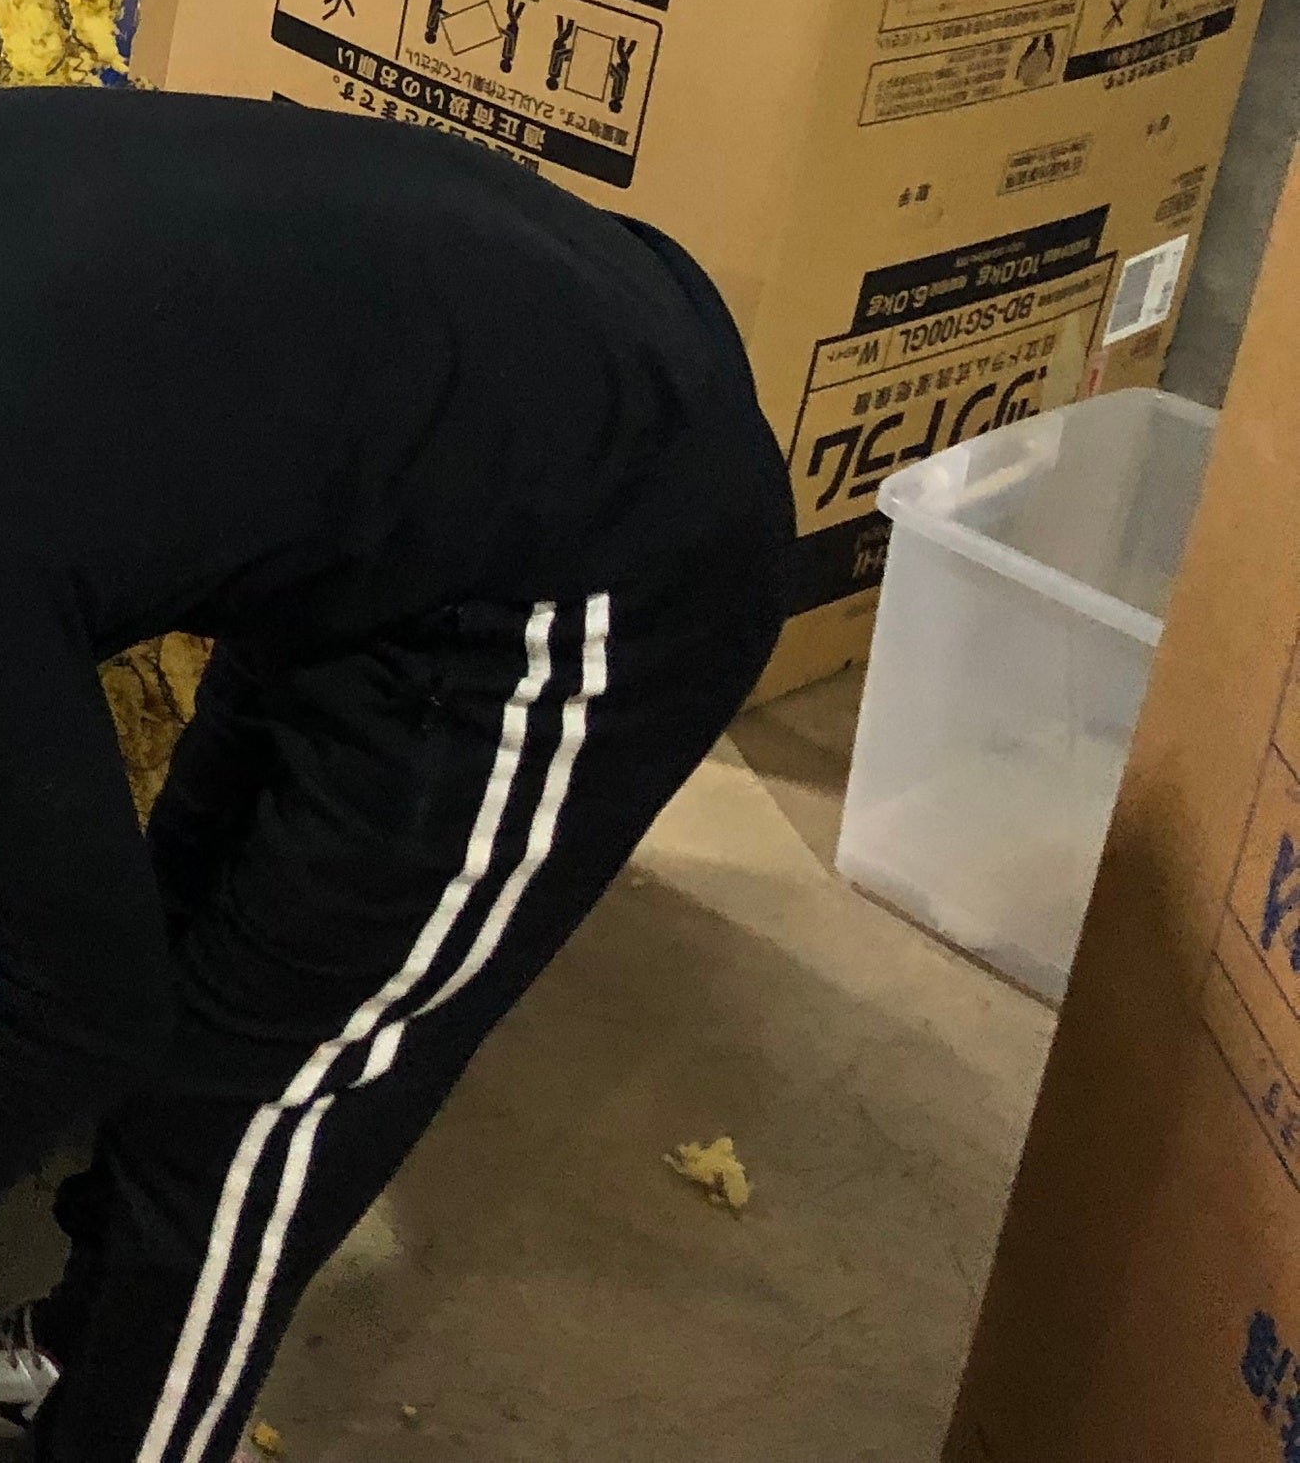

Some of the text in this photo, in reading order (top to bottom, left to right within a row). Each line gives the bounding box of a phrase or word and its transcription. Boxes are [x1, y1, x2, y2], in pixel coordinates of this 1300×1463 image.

[334, 46, 548, 151] 適正荷扱いのお願い
[899, 292, 1037, 355] BD-SG100GL
